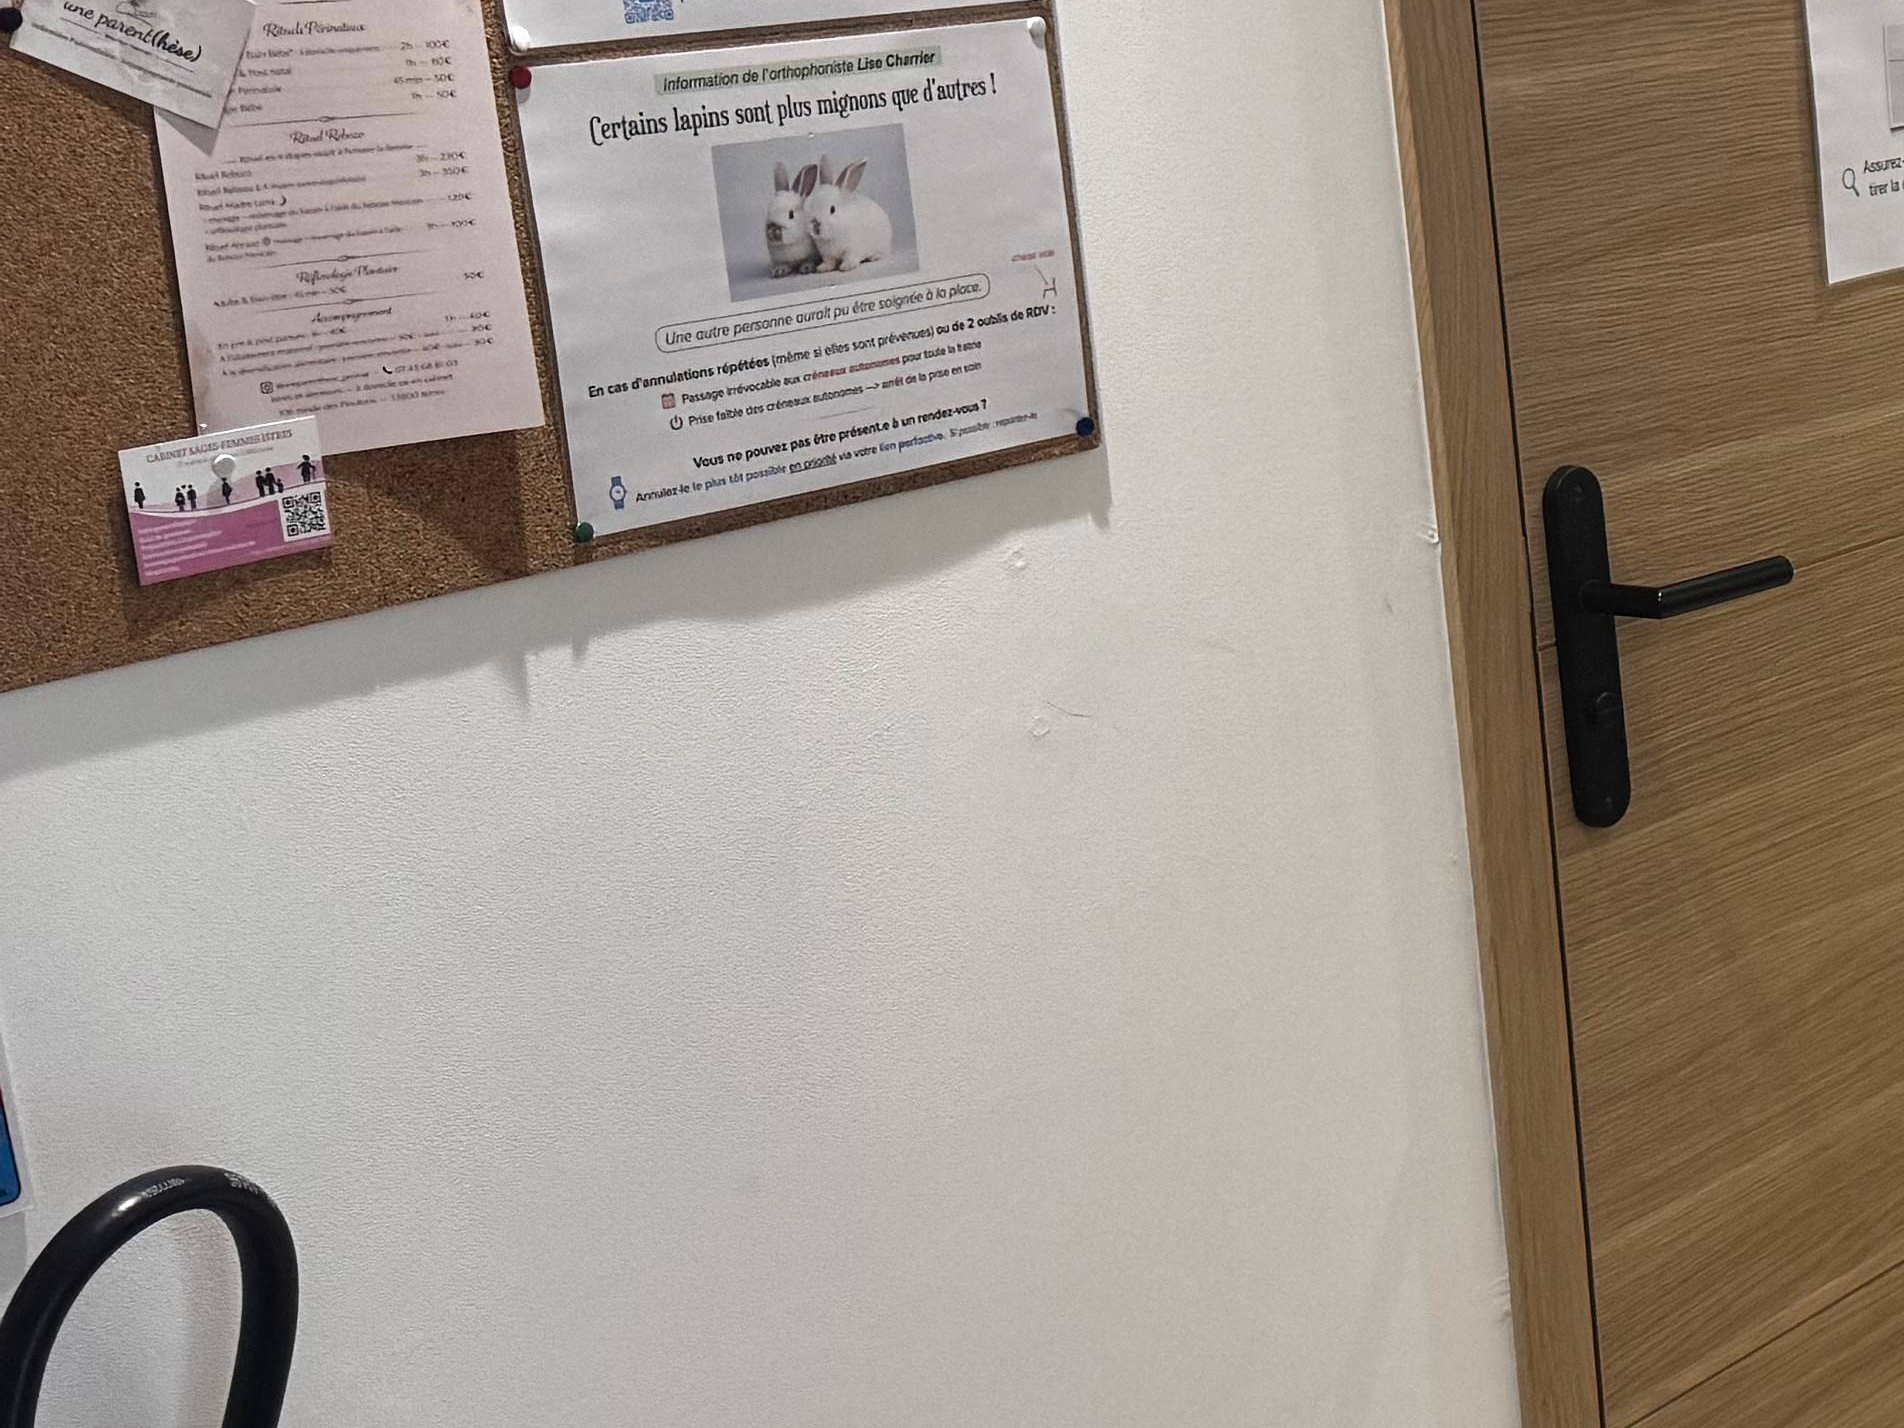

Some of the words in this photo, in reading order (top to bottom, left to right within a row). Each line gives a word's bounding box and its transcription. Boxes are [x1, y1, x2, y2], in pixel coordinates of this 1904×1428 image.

[63, 1, 94, 21] une
[663, 72, 738, 91] Information
[742, 69, 758, 83] de
[761, 59, 854, 82] l'orthophoniste
[856, 56, 882, 73] Lise
[885, 50, 935, 67] Charrier
[589, 111, 668, 146] Certains
[672, 104, 729, 136] lapins
[734, 99, 774, 124] sont
[776, 93, 811, 126] plus
[816, 90, 886, 118] mignons
[891, 88, 918, 111] que
[922, 77, 986, 101] d'autres
[989, 72, 996, 94] !
[1868, 182, 1888, 196] tirer
[1889, 179, 1900, 192] la
[664, 331, 692, 348] Une
[695, 325, 729, 340] autre
[732, 315, 794, 337] personne
[796, 307, 831, 324] aurait
[833, 307, 850, 320] pu
[852, 300, 876, 314] être
[878, 291, 924, 310] soignée
[926, 287, 933, 302] à
[936, 287, 946, 299] la
[948, 283, 982, 300] place.
[587, 385, 604, 398] En
[607, 382, 628, 394] cas
[631, 367, 716, 389] d'annulations
[716, 356, 770, 376] répétées
[771, 350, 810, 368] (même
[813, 345, 822, 358] si
[823, 342, 849, 356] elles
[851, 337, 876, 350] sont
[877, 325, 935, 348] prévenues)
[935, 324, 950, 335] ou
[951, 320, 965, 331] de
[966, 317, 974, 328] 2
[976, 312, 1008, 327] oublis
[1009, 309, 1024, 321] de
[1025, 304, 1049, 318] RDV
[692, 454, 724, 468] Vous
[726, 451, 743, 462] ne
[744, 442, 788, 462] pouvez
[789, 437, 811, 452] pas
[813, 432, 836, 445] être
[891, 417, 899, 429] à
[900, 416, 915, 427] un
[917, 402, 979, 423] rendez-vous
